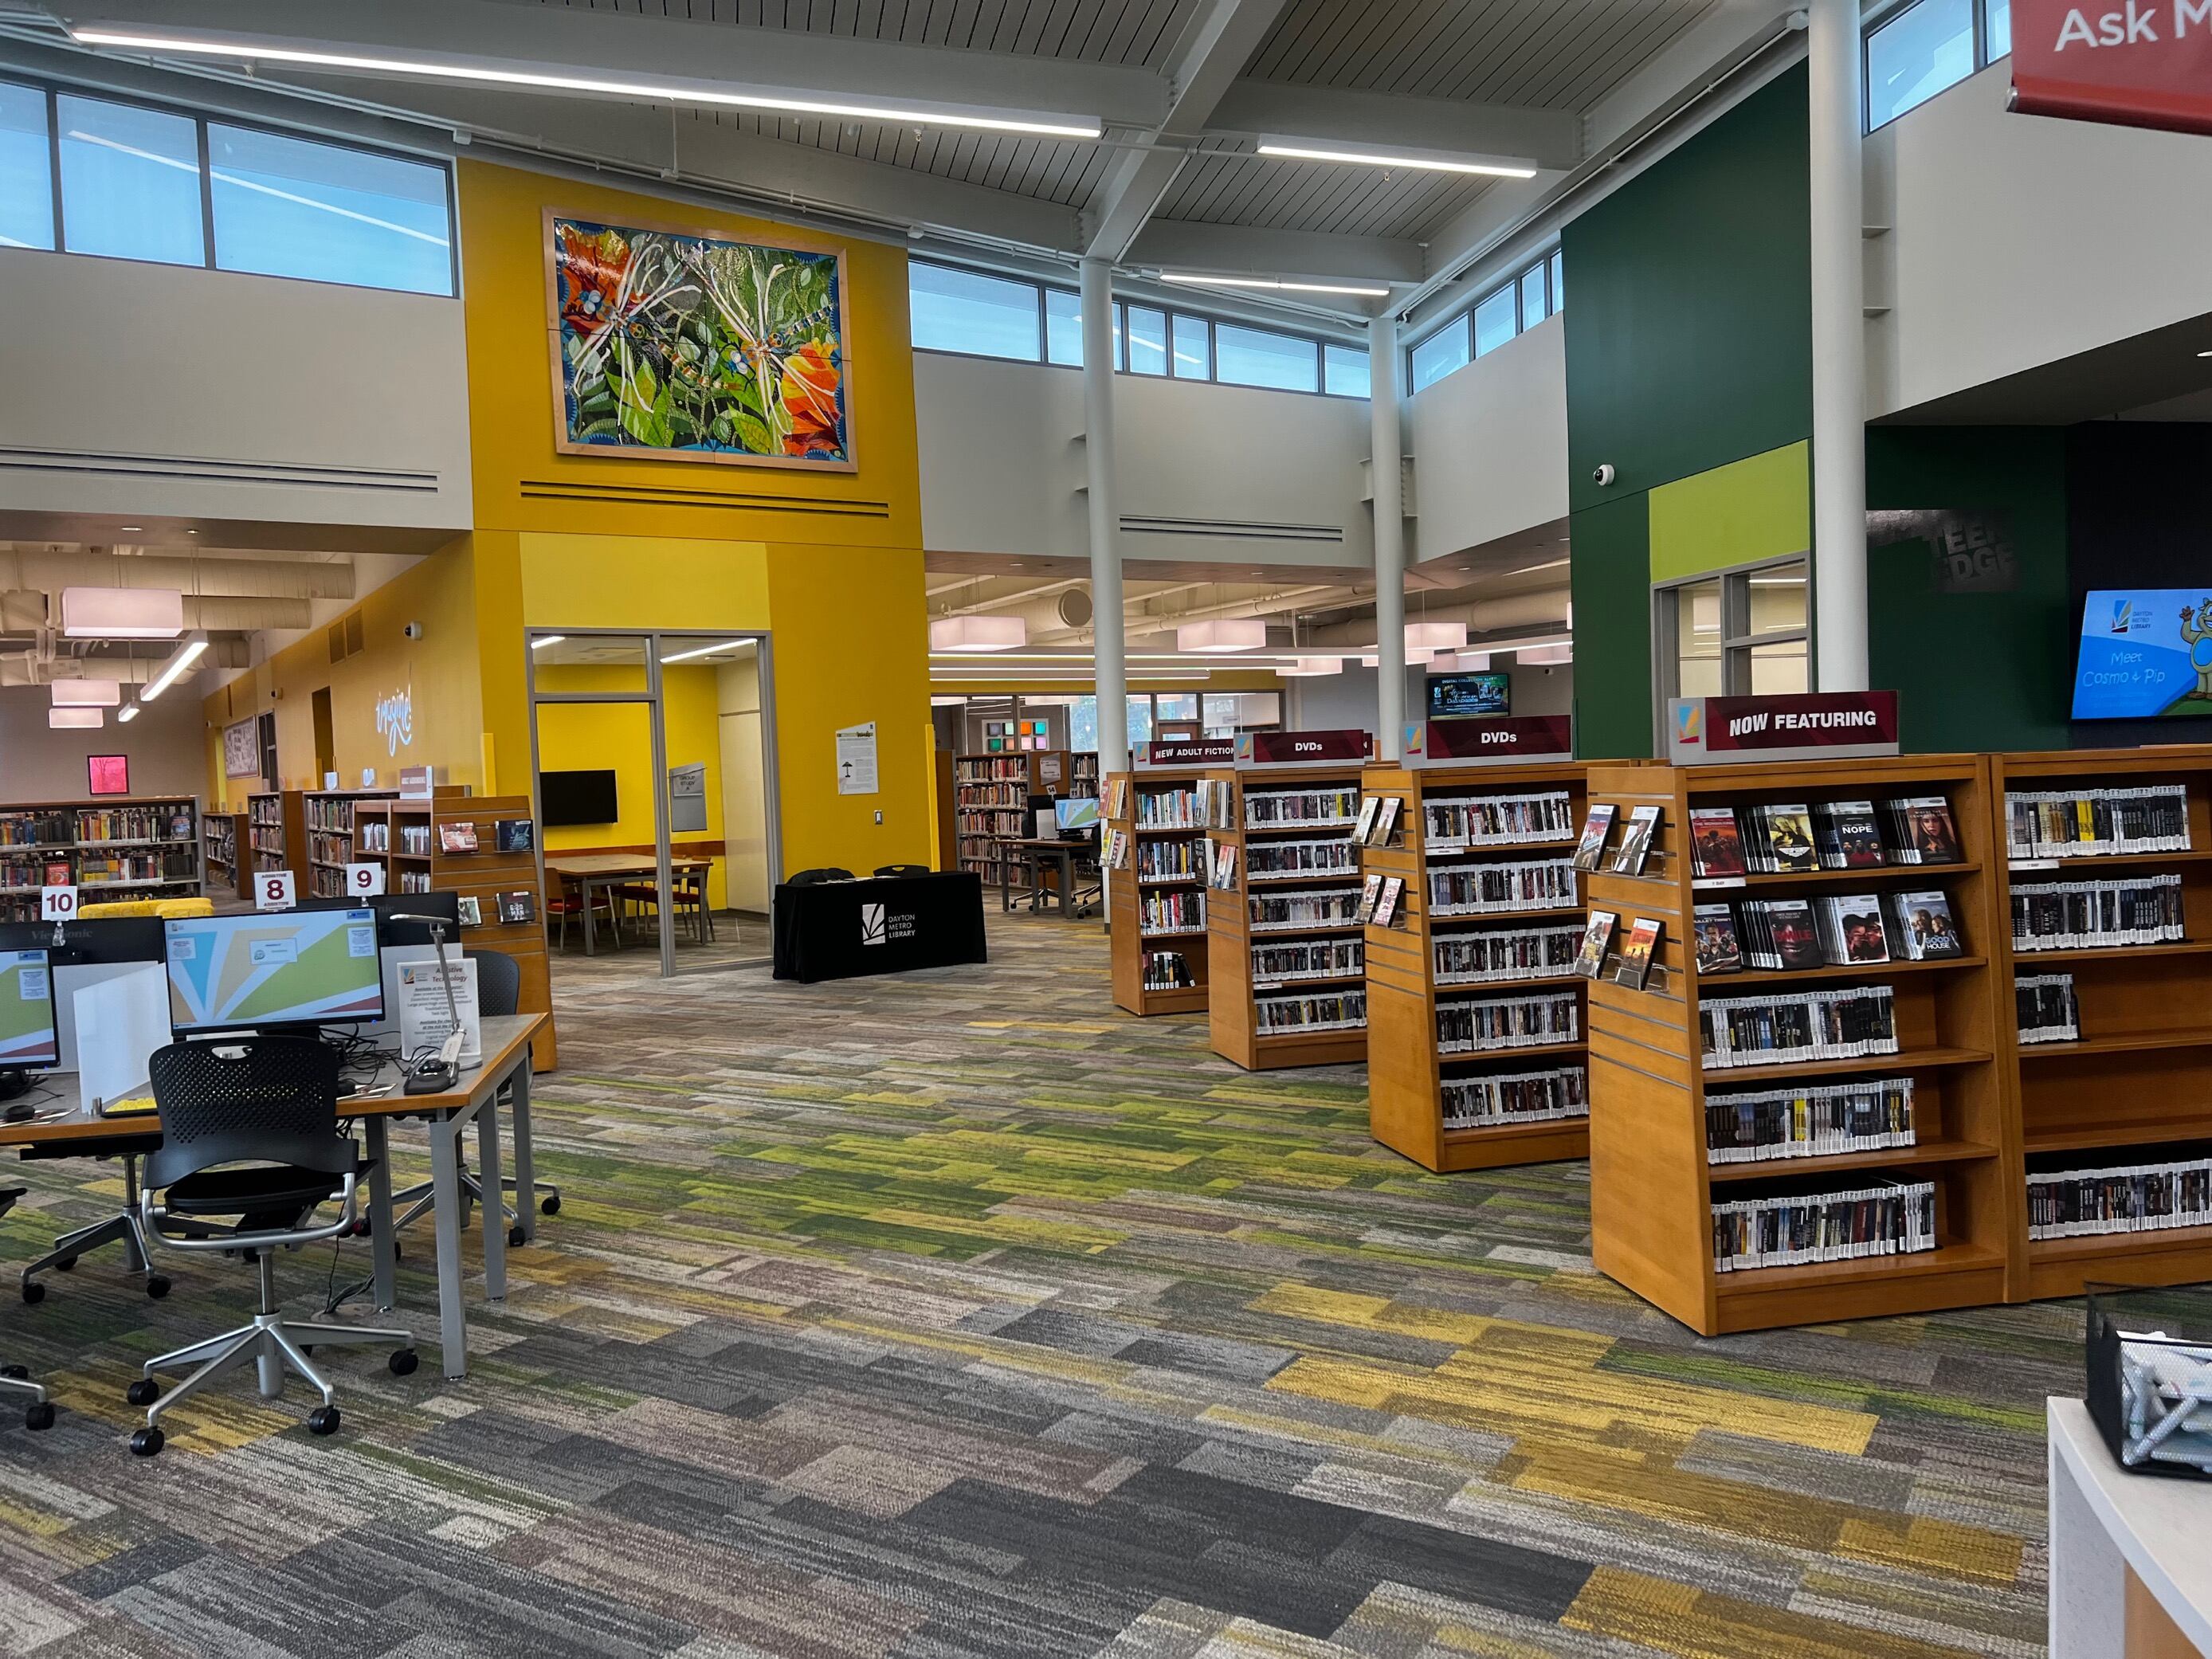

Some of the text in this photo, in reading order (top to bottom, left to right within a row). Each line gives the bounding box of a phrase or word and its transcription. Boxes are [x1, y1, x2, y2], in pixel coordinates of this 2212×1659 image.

[2053, 0, 2159, 52] Ask
[2112, 651, 2143, 665] Meet
[2082, 671, 2128, 687] Cosmo
[2143, 668, 2165, 684] Pip
[1729, 710, 1877, 737] NOW FEATURING
[1481, 731, 1517, 743] DVDs
[1294, 742, 1323, 751] DVDs
[1155, 747, 1174, 759] NEW
[1176, 747, 1202, 756] ADULT
[1841, 826, 1873, 834] NOPE
[356, 870, 372, 888] 9
[267, 880, 284, 900] 8
[46, 893, 73, 912] 10
[888, 914, 916, 923] DAYTON
[888, 922, 912, 931] METRO
[31, 929, 93, 940] Vieonic
[888, 929, 916, 939] LIBRARY
